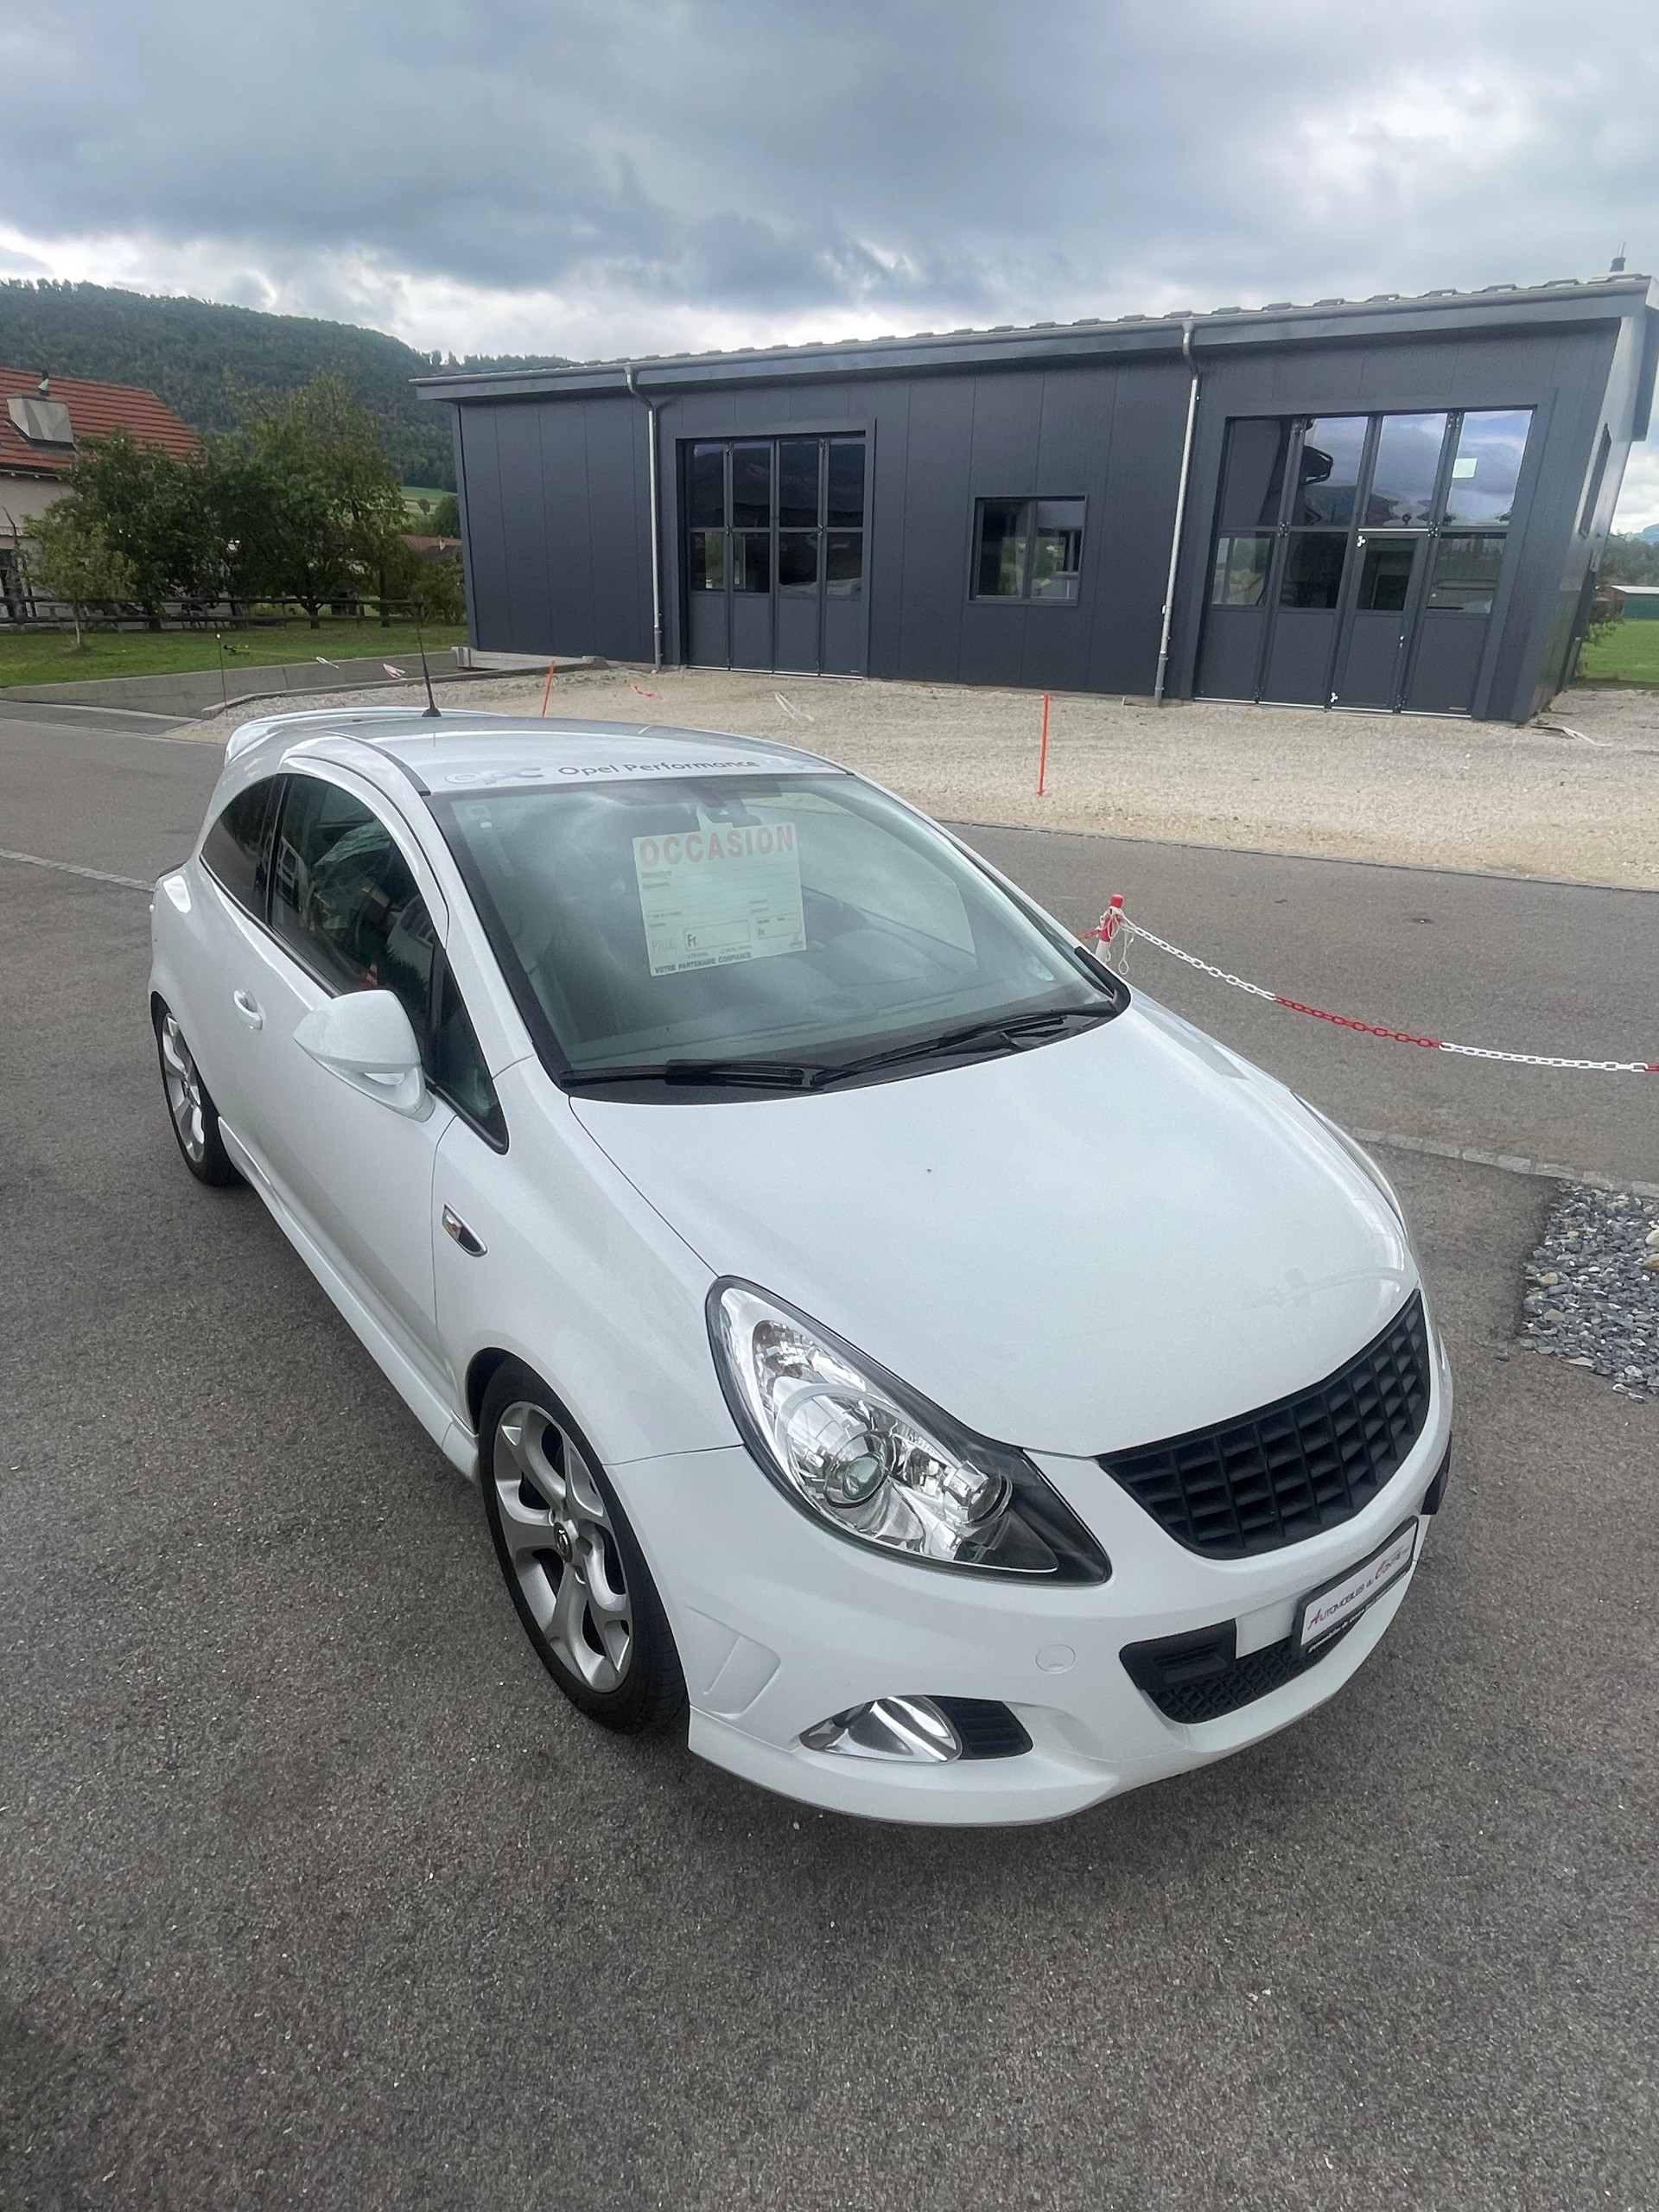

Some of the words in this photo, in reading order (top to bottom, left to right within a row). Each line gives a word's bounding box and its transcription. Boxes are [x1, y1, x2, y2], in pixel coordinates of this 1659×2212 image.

[558, 764, 620, 776] Opel
[623, 760, 760, 772] Performance
[639, 824, 794, 868] OCCASION
[654, 963, 677, 974] VOTRE
